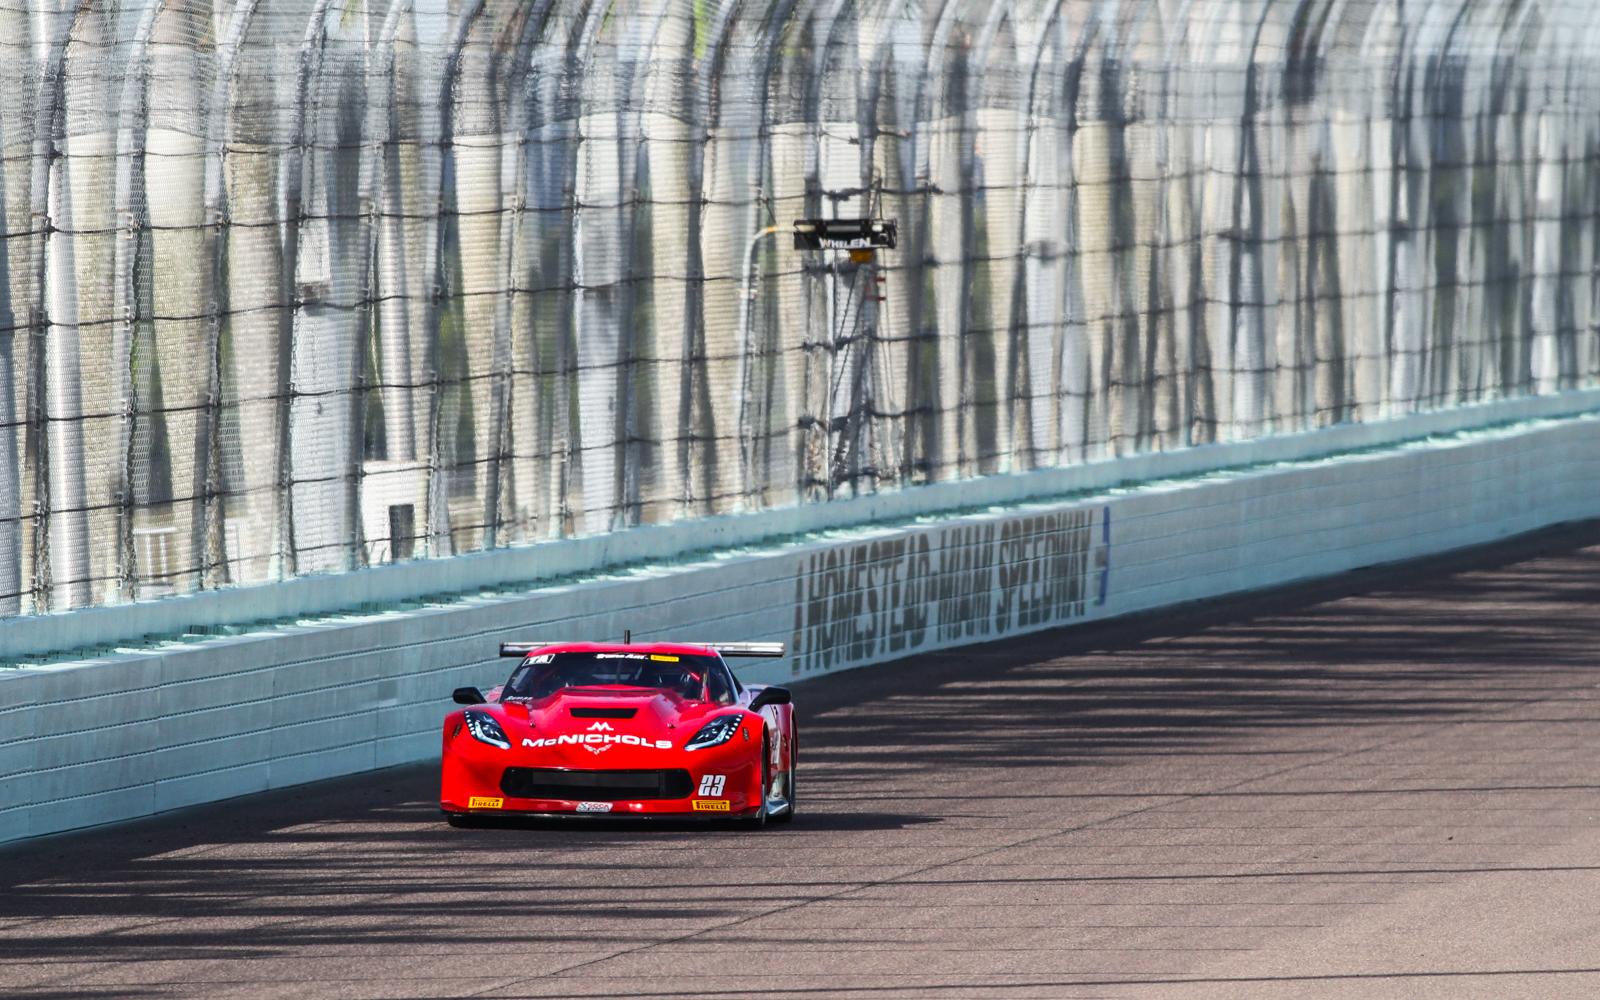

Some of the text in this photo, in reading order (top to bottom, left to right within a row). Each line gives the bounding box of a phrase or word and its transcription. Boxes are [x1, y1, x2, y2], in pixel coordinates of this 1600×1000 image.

[995, 508, 1093, 634] SPEEDWAY
[521, 733, 673, 749] McNICHOLS
[698, 774, 726, 797] 23
[471, 798, 499, 807] PIRELLI
[696, 800, 727, 810] PIRELLI
